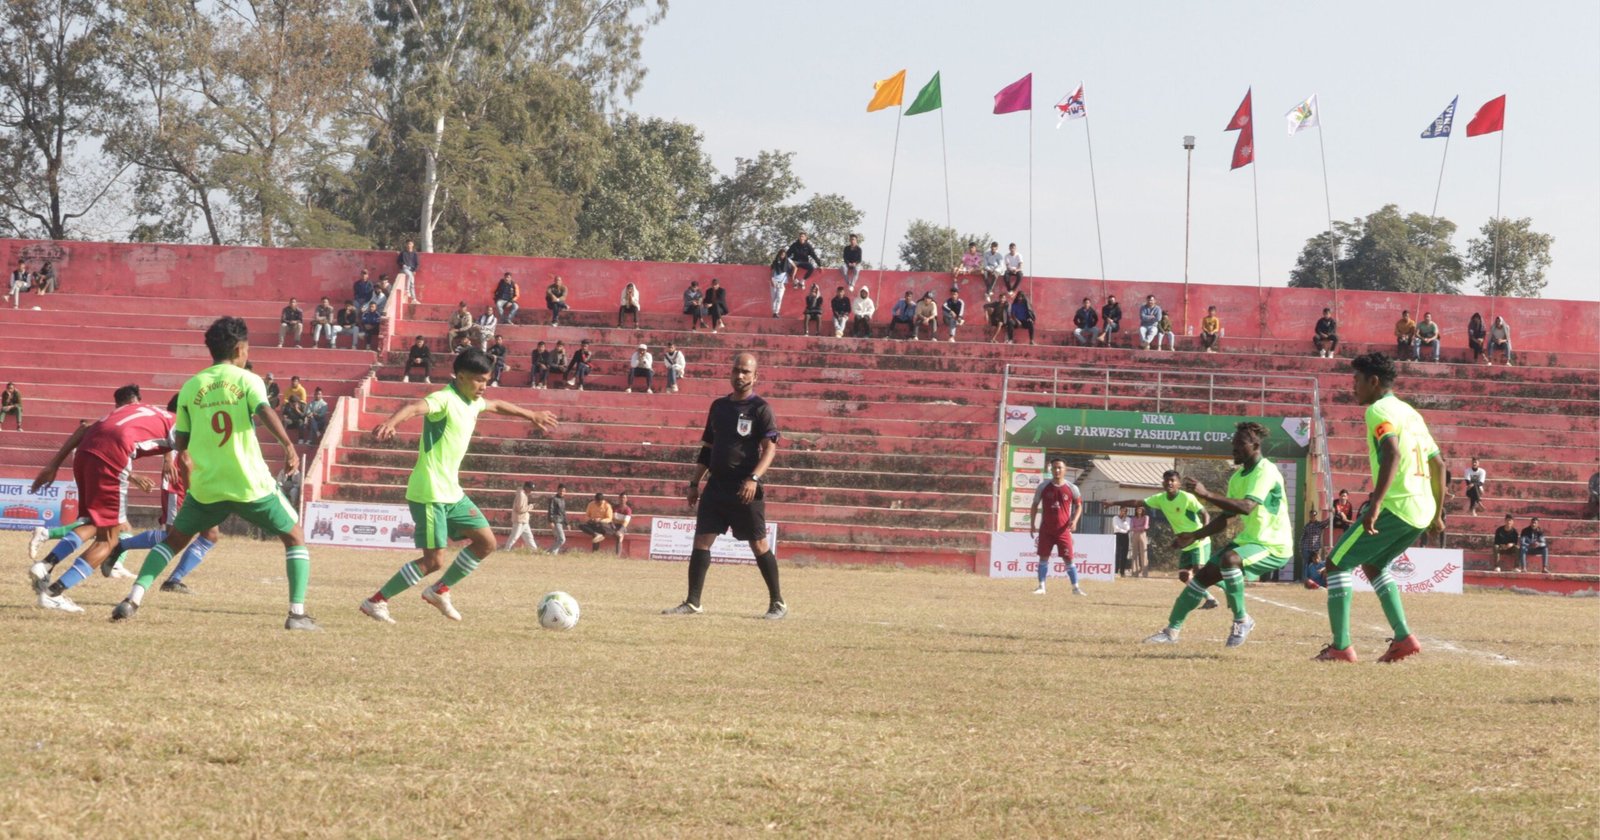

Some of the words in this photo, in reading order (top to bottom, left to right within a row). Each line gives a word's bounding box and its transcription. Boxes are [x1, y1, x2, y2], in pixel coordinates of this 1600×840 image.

[207, 380, 230, 392] YOUTH
[115, 406, 157, 426] 7
[1141, 413, 1176, 425] NRNA
[211, 410, 233, 448] 9
[1056, 424, 1071, 436] 6th
[1073, 425, 1131, 439] FARWEST
[1134, 428, 1201, 442] PASHUPATI
[656, 520, 671, 529] Om
